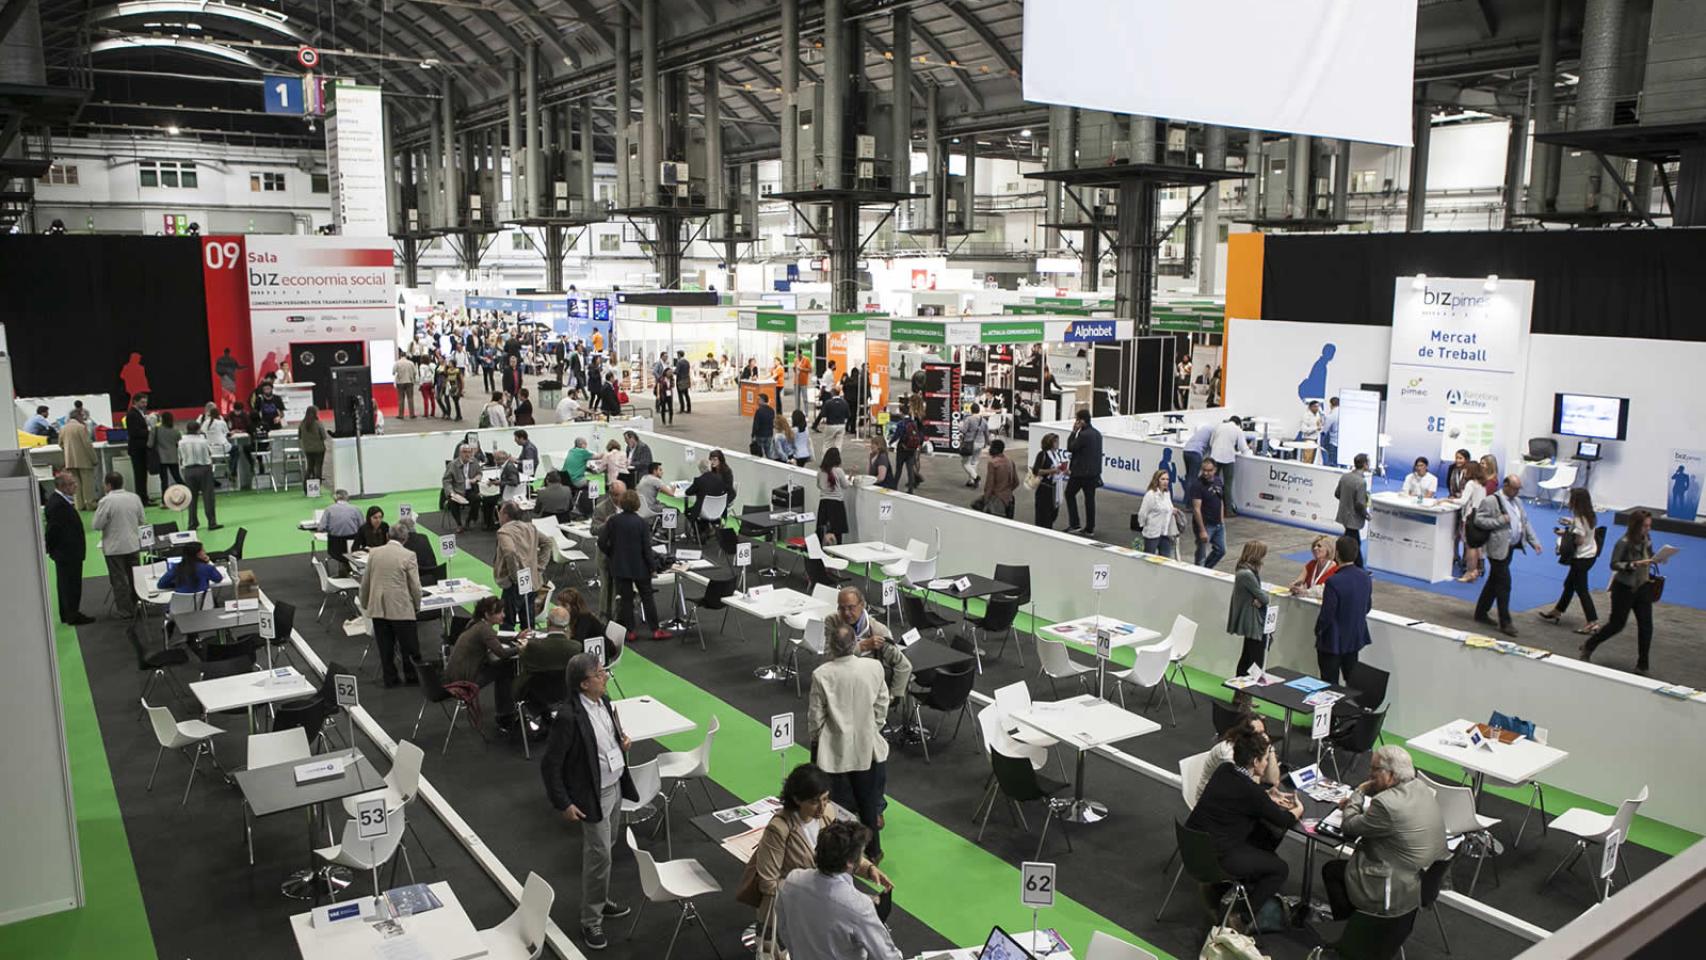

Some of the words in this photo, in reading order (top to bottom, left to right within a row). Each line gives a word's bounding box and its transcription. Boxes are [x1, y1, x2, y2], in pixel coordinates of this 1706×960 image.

[275, 83, 289, 107] 1
[206, 241, 240, 269] 09
[248, 252, 277, 263] Sala
[250, 268, 280, 287] biz
[281, 273, 348, 286] economia
[350, 272, 386, 286] social
[1074, 325, 1113, 339] Alphabet
[1431, 330, 1477, 344] Mercat
[1418, 346, 1434, 357] de
[1439, 347, 1487, 361] Treball
[1401, 386, 1428, 396] pimec
[951, 411, 962, 449] GRUPO
[1269, 465, 1313, 487] bizpimes
[664, 513, 676, 522] 67
[142, 530, 152, 540] 49
[442, 540, 454, 550] 58
[738, 548, 750, 559] 68
[519, 575, 529, 587] 59
[1095, 571, 1107, 580] 79
[884, 585, 894, 597] 69
[261, 617, 272, 629] 51
[1098, 636, 1109, 649] 70
[588, 644, 602, 656] 60
[338, 683, 355, 697] 52
[1315, 713, 1327, 728] 71
[774, 723, 790, 739] 61
[361, 807, 385, 826] 53
[1026, 874, 1051, 893] 62
